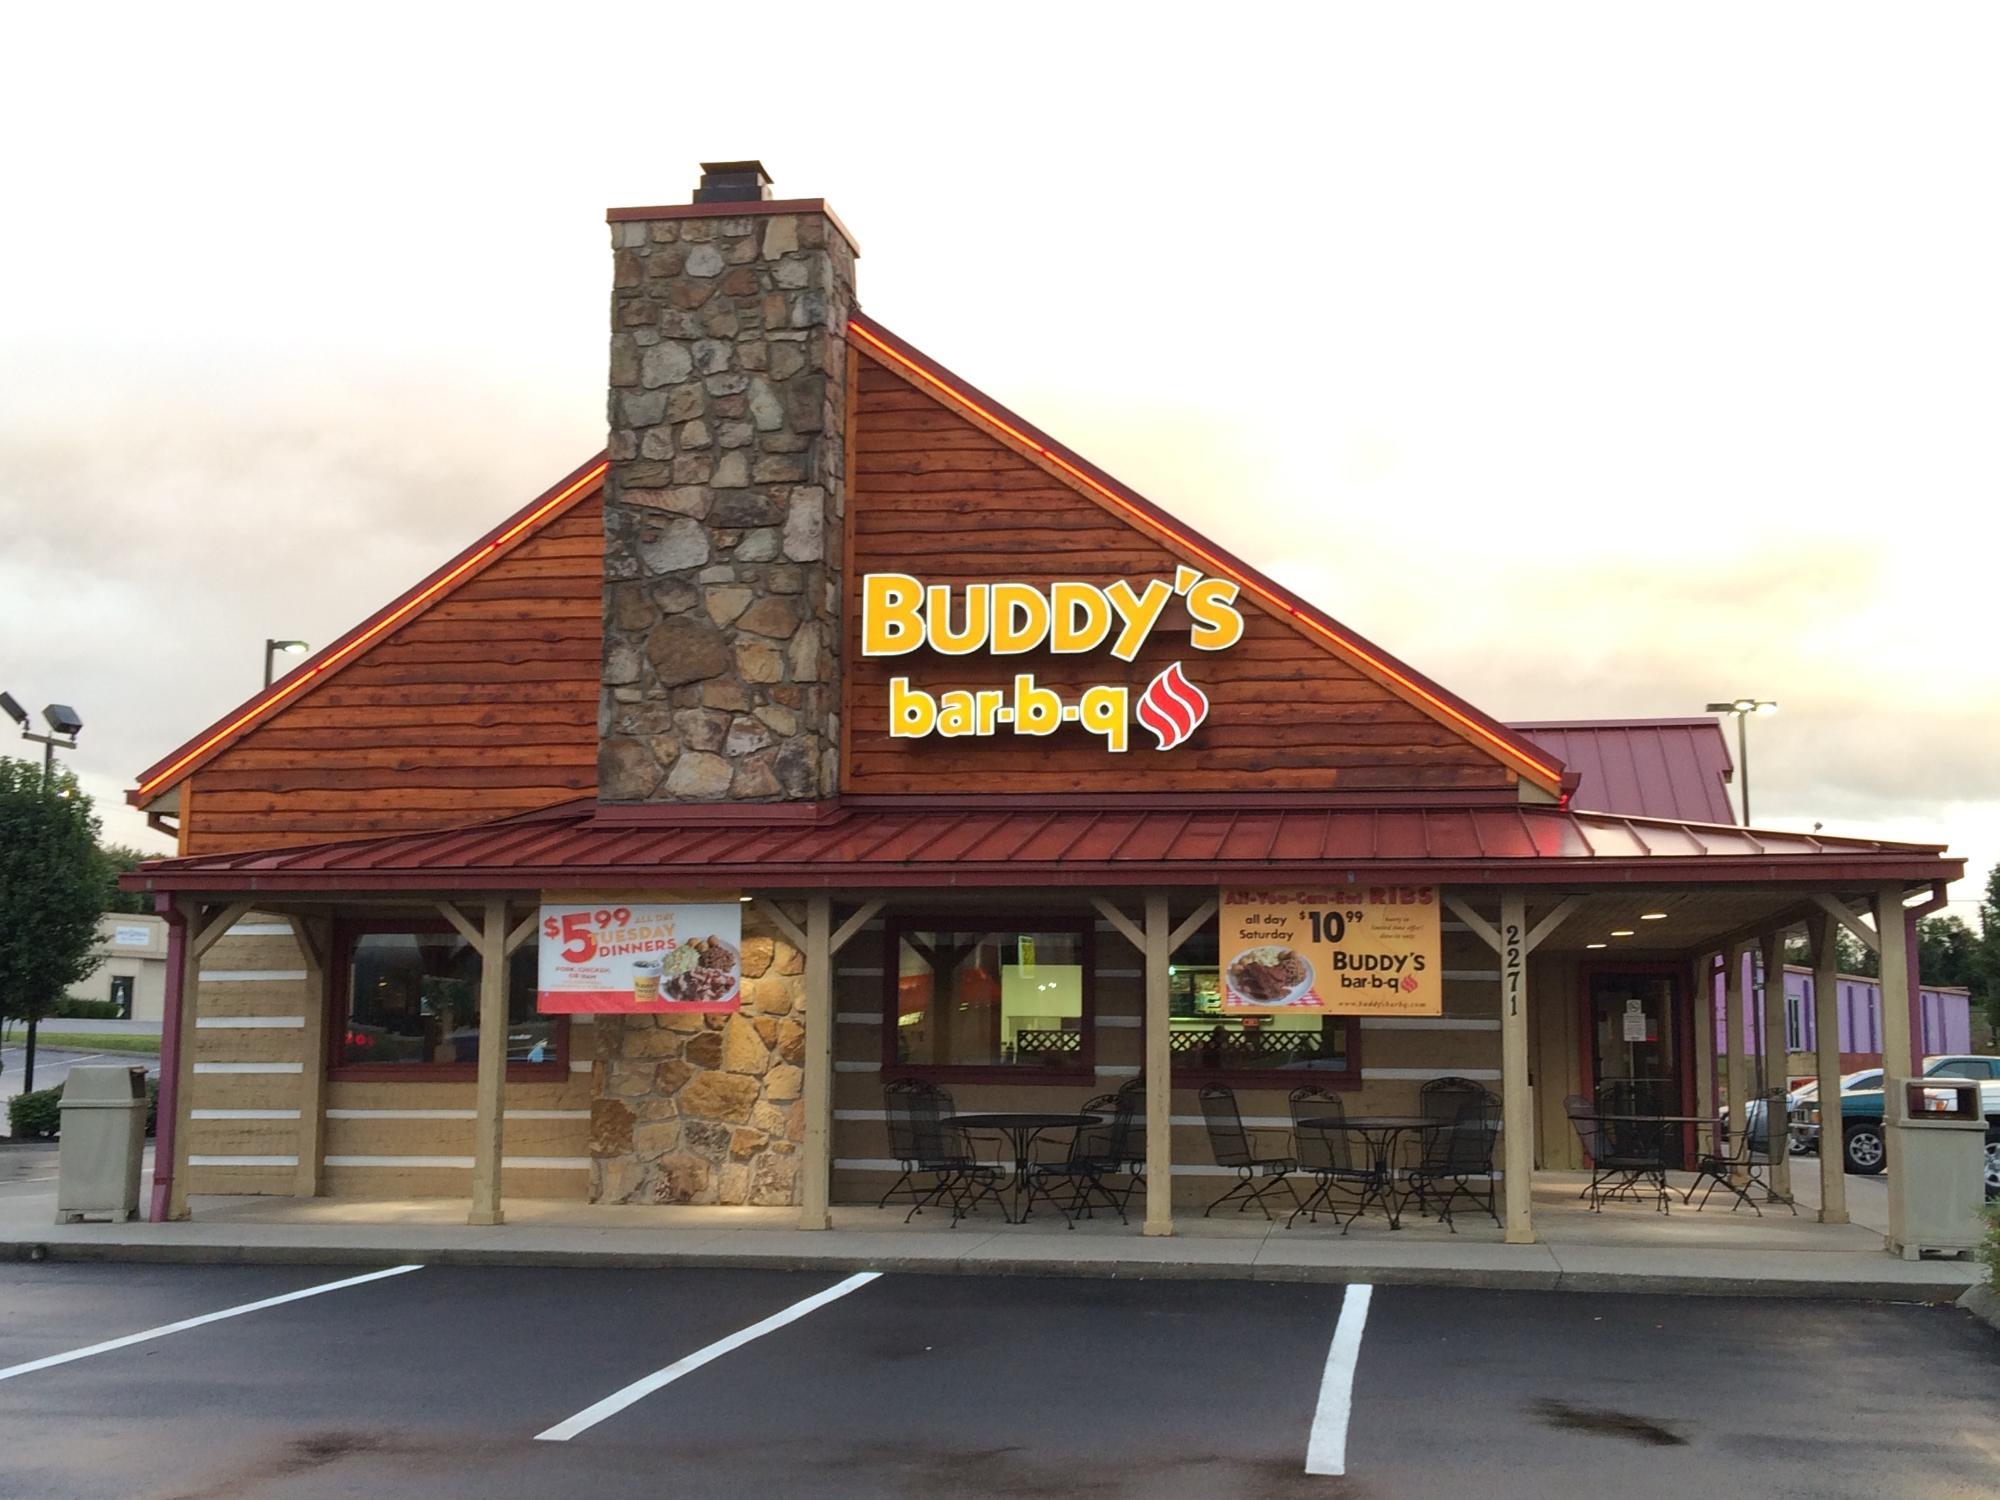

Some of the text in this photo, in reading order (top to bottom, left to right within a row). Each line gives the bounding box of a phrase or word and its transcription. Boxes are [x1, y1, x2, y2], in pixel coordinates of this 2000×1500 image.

[862, 565, 1244, 662] BUDDY'S
[890, 674, 1128, 752] bar-b-q
[1369, 887, 1434, 905] RIBS
[1245, 914, 1288, 927] all day
[588, 923, 675, 945] TUESDAY
[1239, 929, 1294, 942] Saturday
[599, 938, 677, 958] DINNERS
[1333, 951, 1426, 973] BUDDY'S
[1341, 974, 1399, 993] bar-b-q
